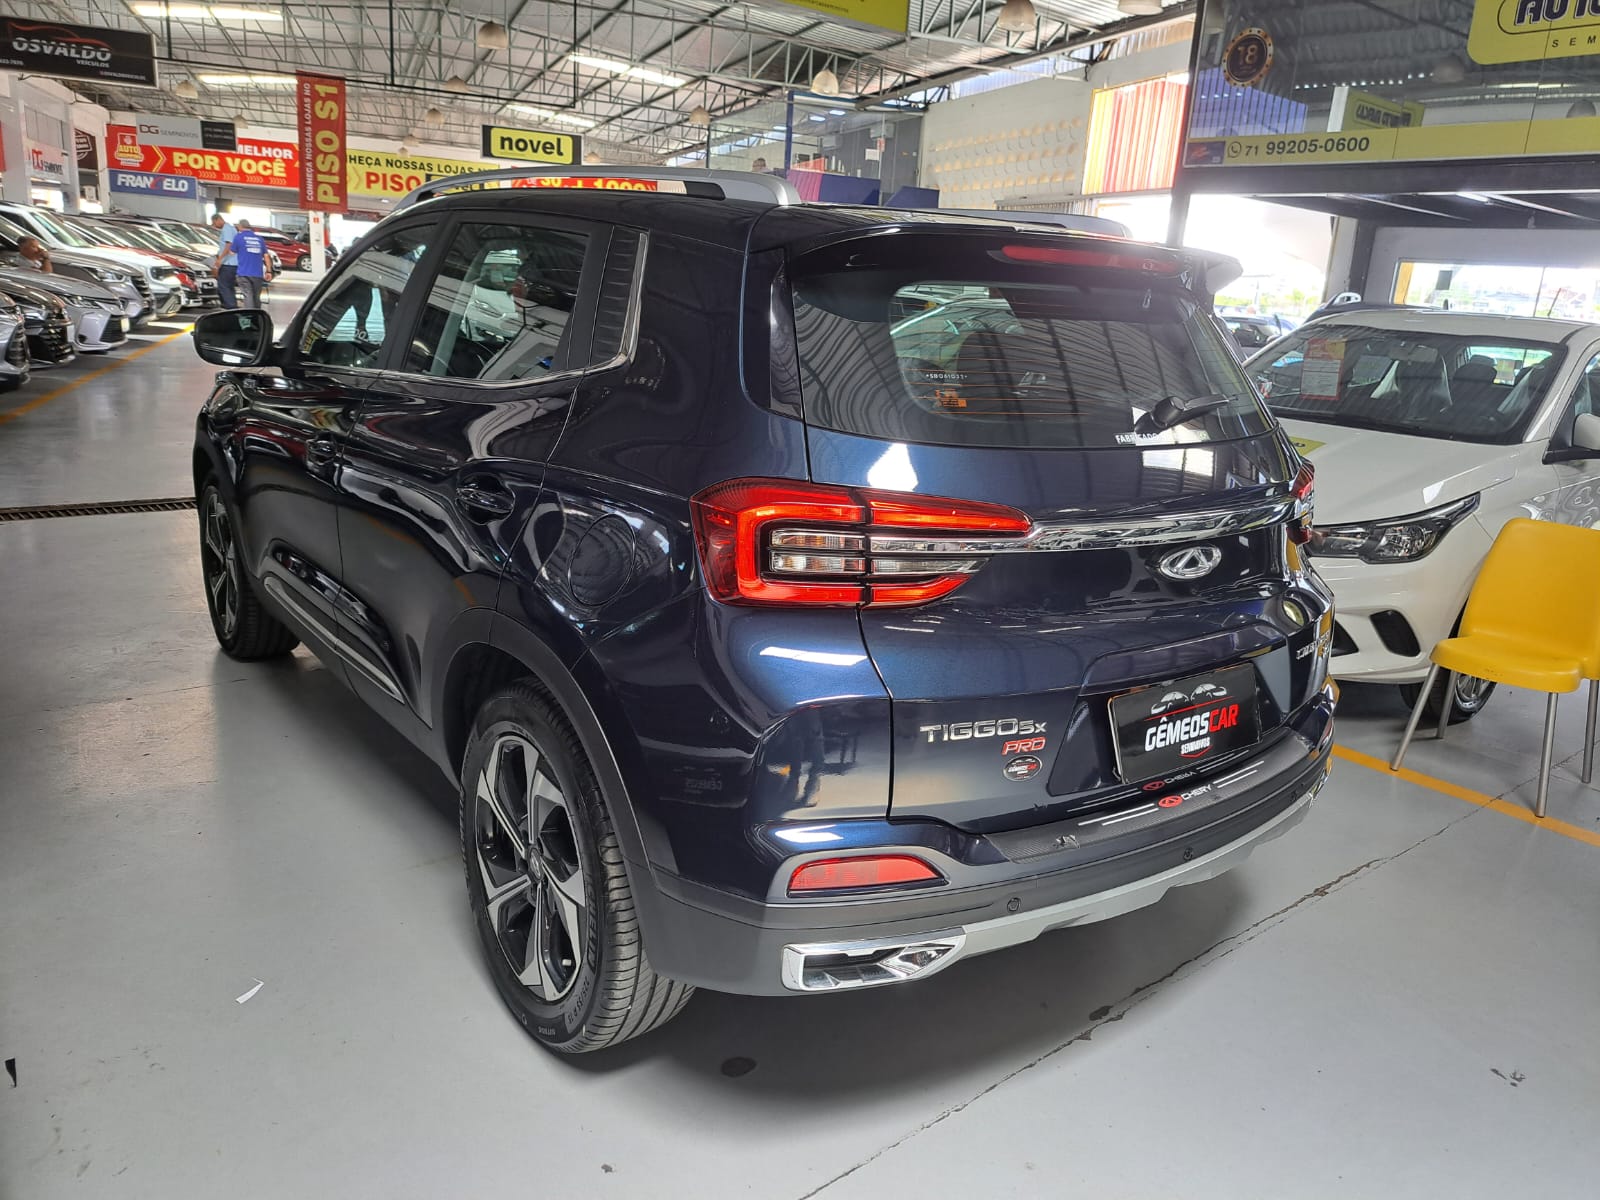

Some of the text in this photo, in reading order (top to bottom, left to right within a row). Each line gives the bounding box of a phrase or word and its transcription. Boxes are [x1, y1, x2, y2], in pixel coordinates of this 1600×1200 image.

[12, 37, 112, 61] OSVALDO
[303, 83, 314, 201] CONHEÇA NOSSAS LOJAS NO
[314, 84, 340, 204] PISO S1
[500, 136, 564, 157] novel
[1245, 137, 1370, 157] 71 99205-0600
[172, 151, 287, 178] POR VOCÊ
[385, 158, 434, 173] NOSSAS
[365, 171, 422, 193] PISO
[1144, 703, 1239, 752] GÊMEOSCAR
[1001, 736, 1046, 755] PRO
[1181, 784, 1212, 801] CHERY
